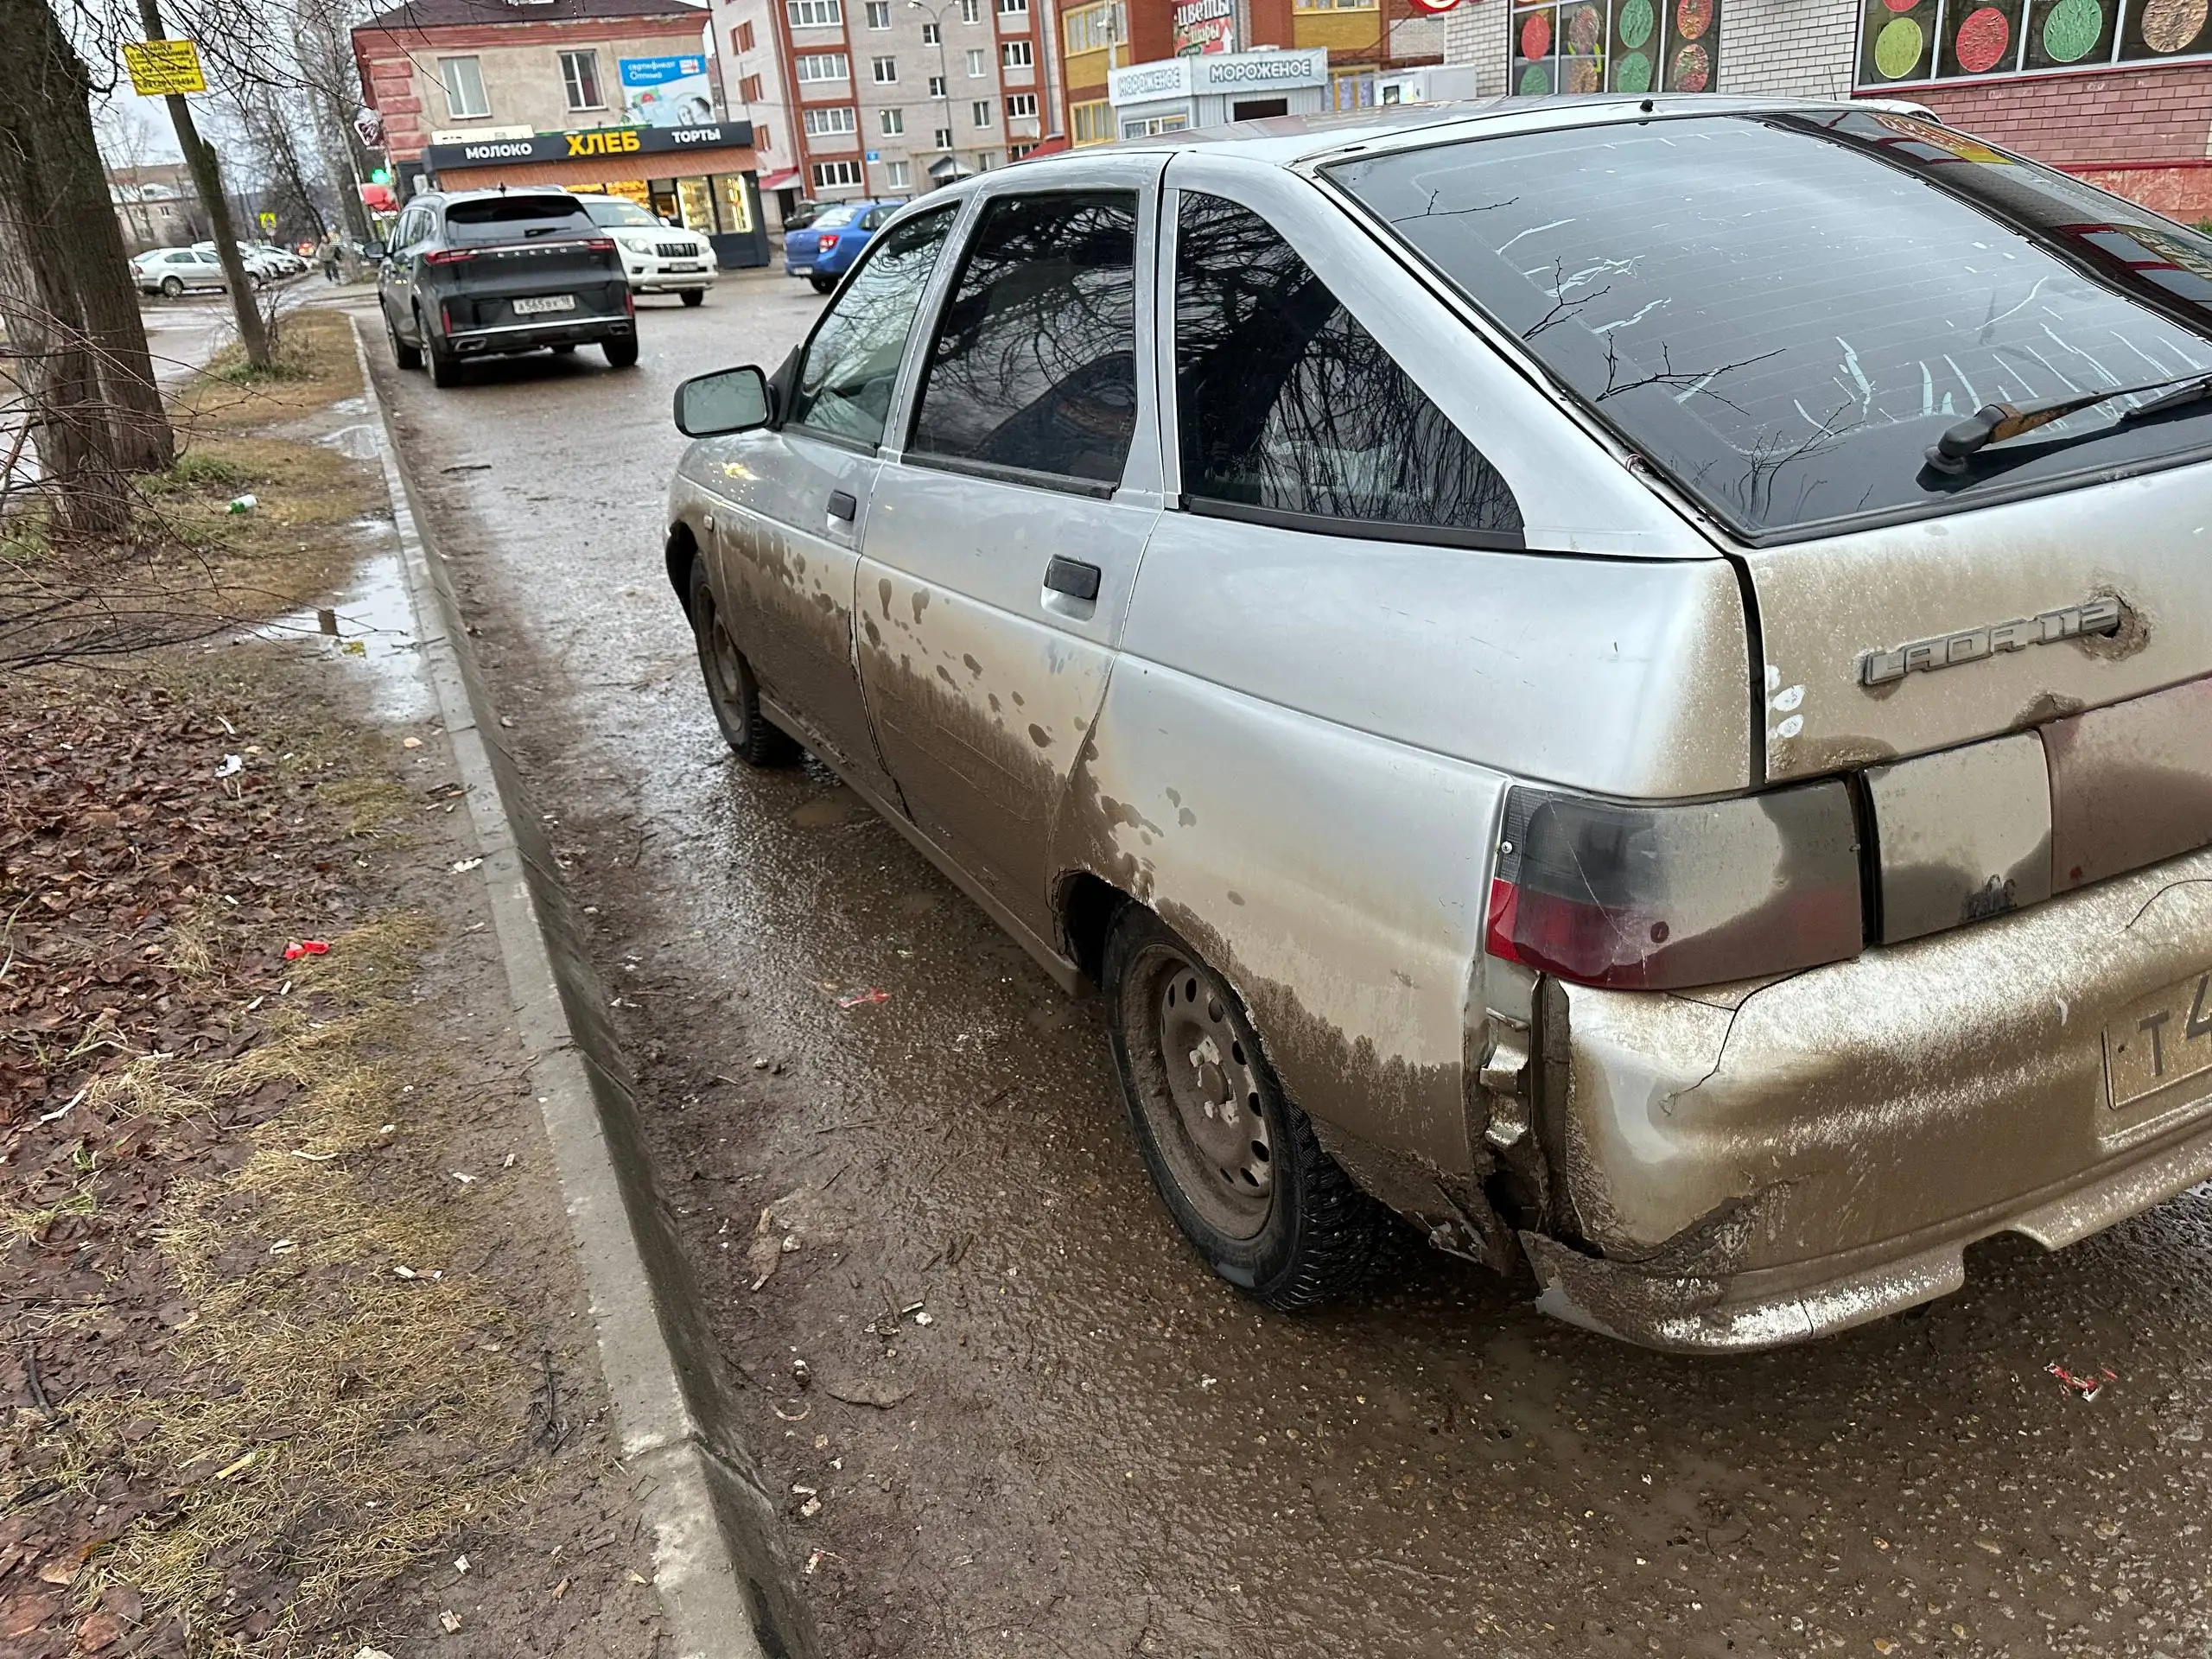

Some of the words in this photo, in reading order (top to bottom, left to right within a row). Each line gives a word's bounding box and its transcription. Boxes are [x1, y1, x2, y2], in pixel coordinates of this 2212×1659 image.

[1118, 66, 1181, 98] МОРОЖЕНОЕ
[1210, 59, 1312, 83] МОРОЖЕНОЕ
[465, 142, 533, 160] МОЛОКО
[565, 130, 640, 156] ХЛЕБ
[671, 128, 721, 143] ТОРТЫ
